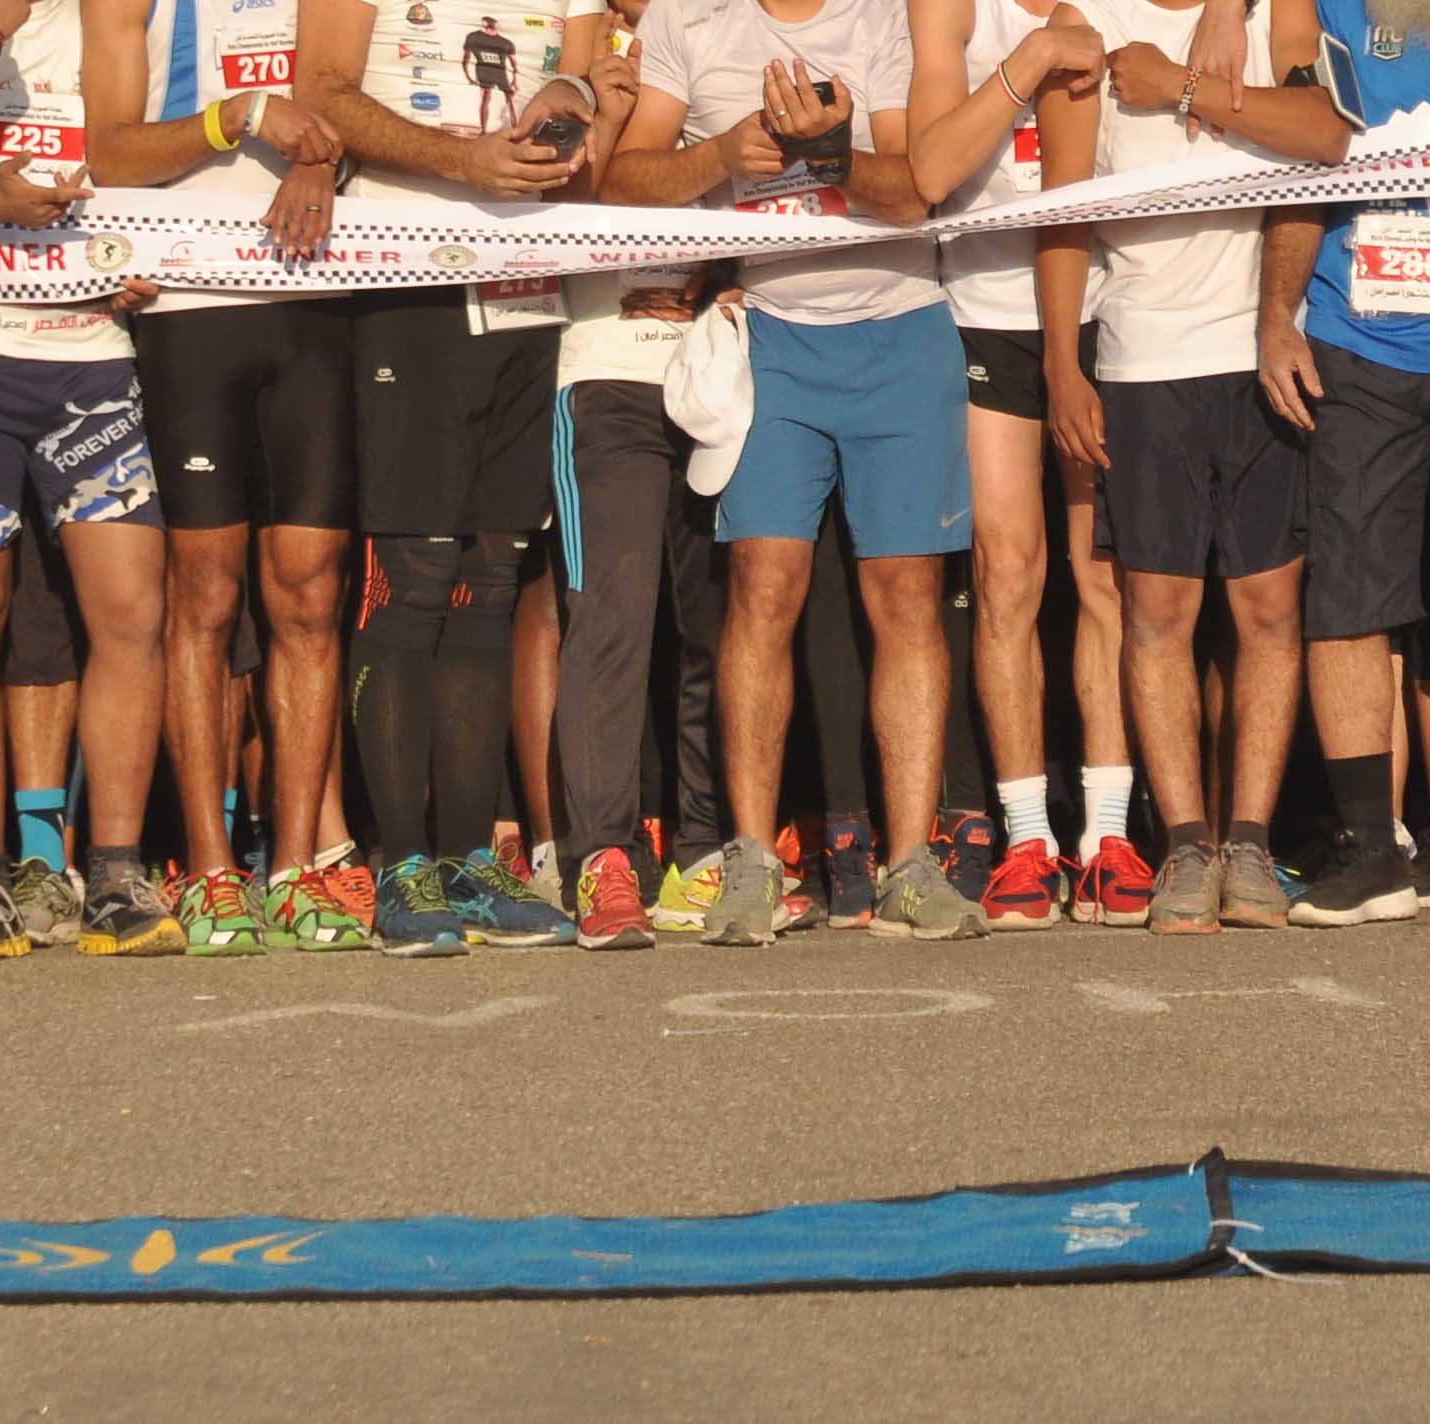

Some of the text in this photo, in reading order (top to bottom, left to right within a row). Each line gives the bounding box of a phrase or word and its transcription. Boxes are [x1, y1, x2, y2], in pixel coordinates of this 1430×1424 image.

[237, 53, 290, 84] 270
[2, 124, 62, 156] 225
[53, 418, 134, 474] FOREVER
